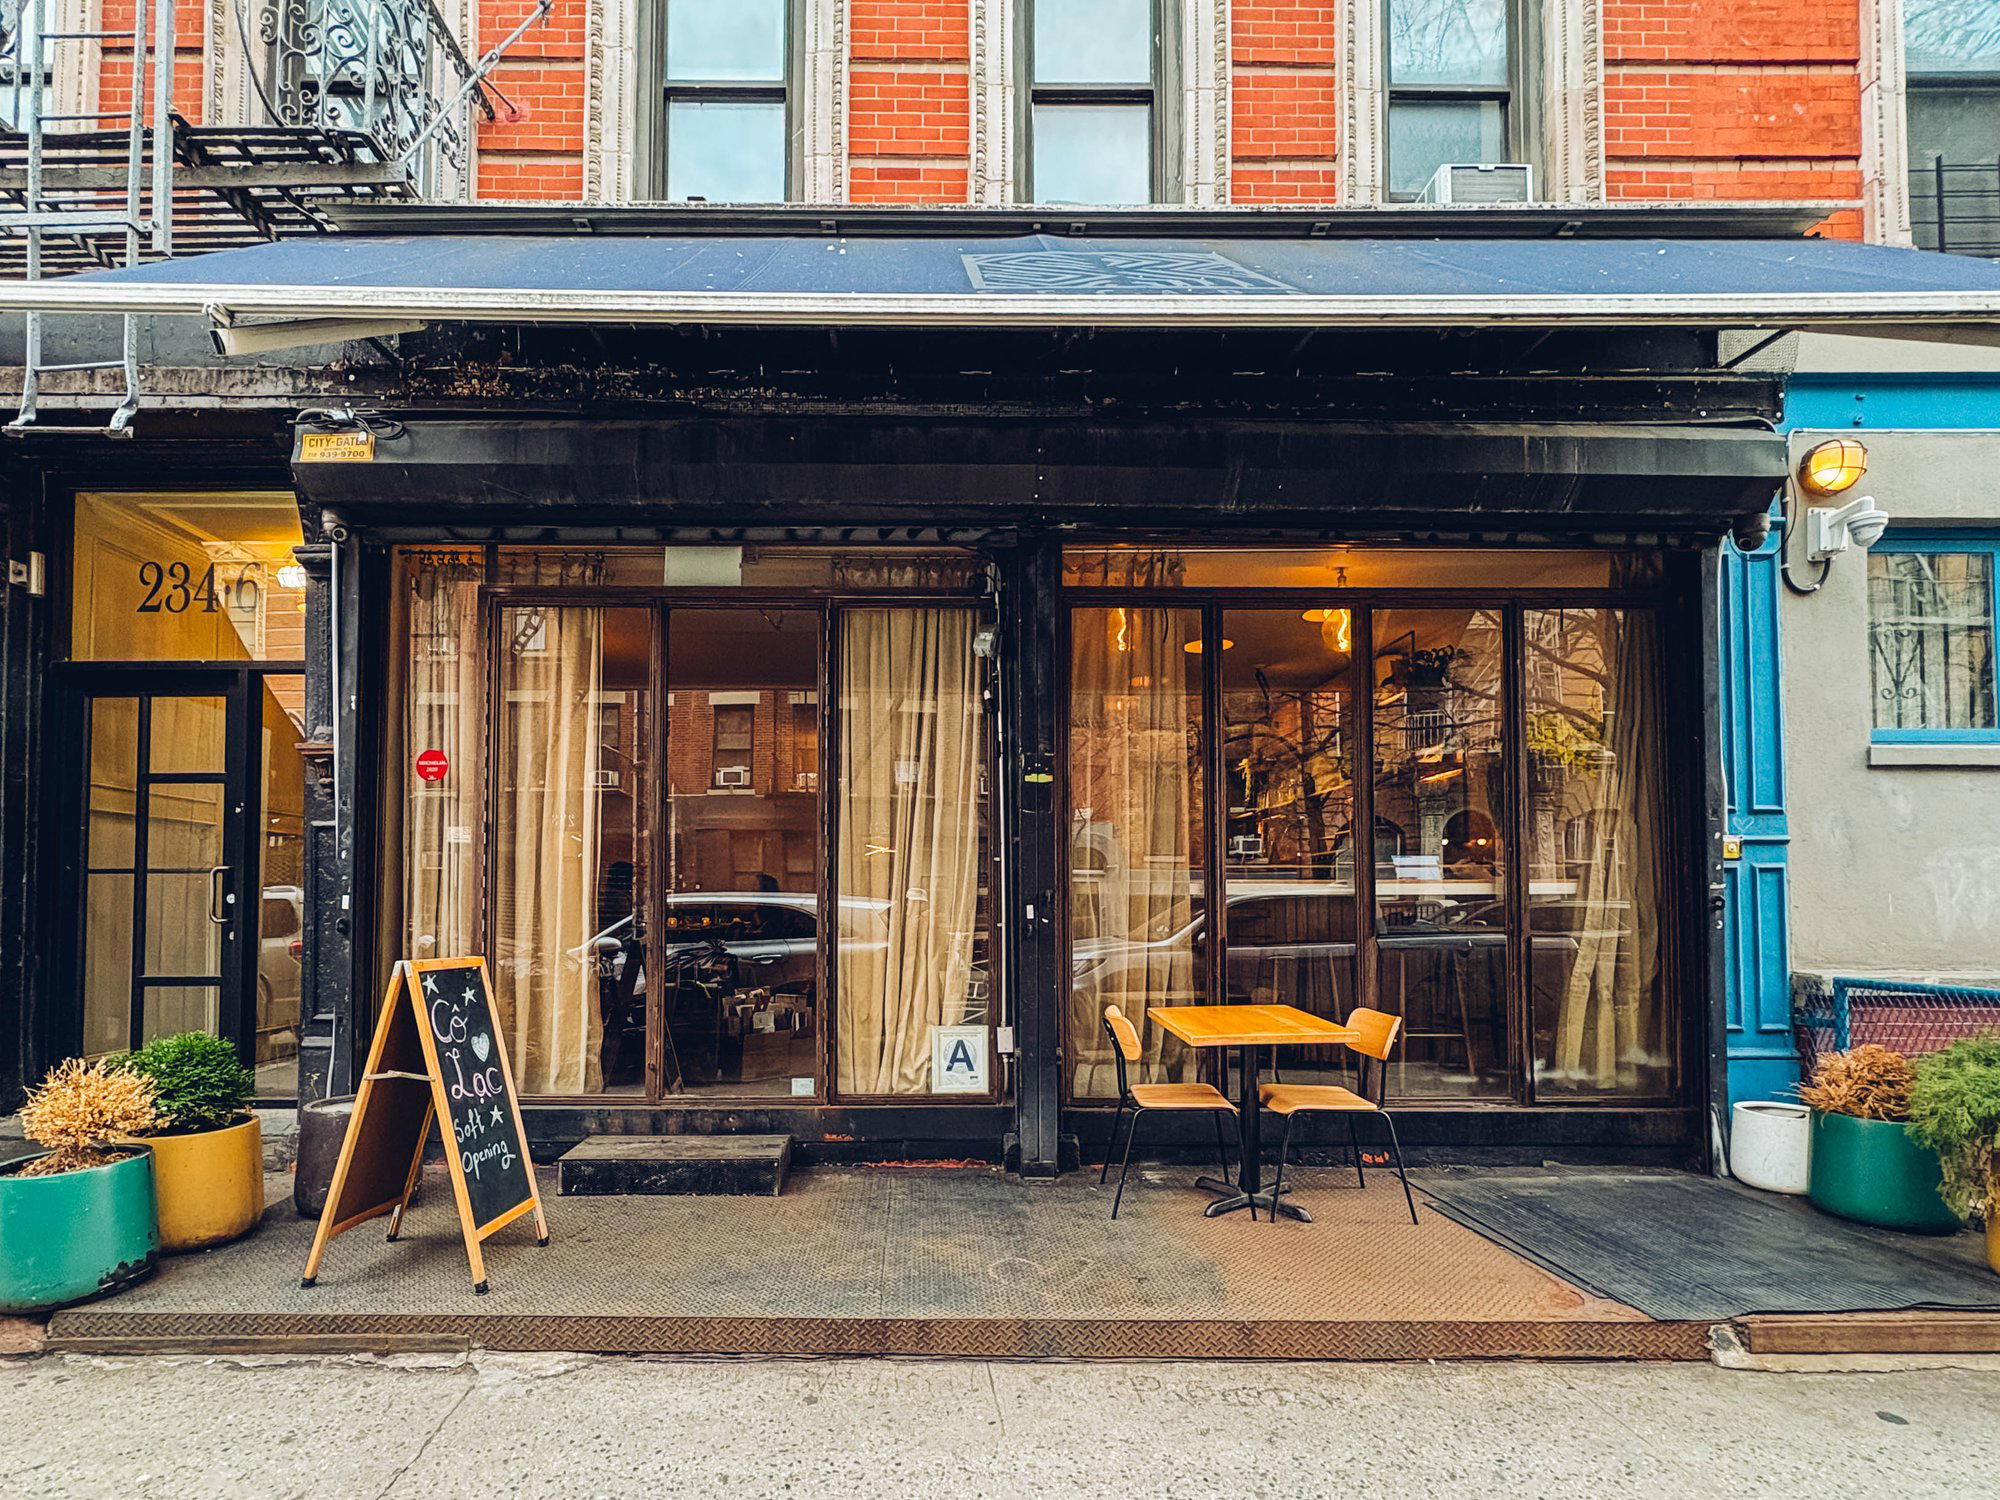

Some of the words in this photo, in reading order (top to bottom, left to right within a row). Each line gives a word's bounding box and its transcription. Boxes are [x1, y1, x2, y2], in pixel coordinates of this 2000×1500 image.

[430, 998, 469, 1043] Cô
[946, 1040, 975, 1071] A
[453, 1107, 486, 1144] Soft
[462, 1140, 516, 1180] Opening
